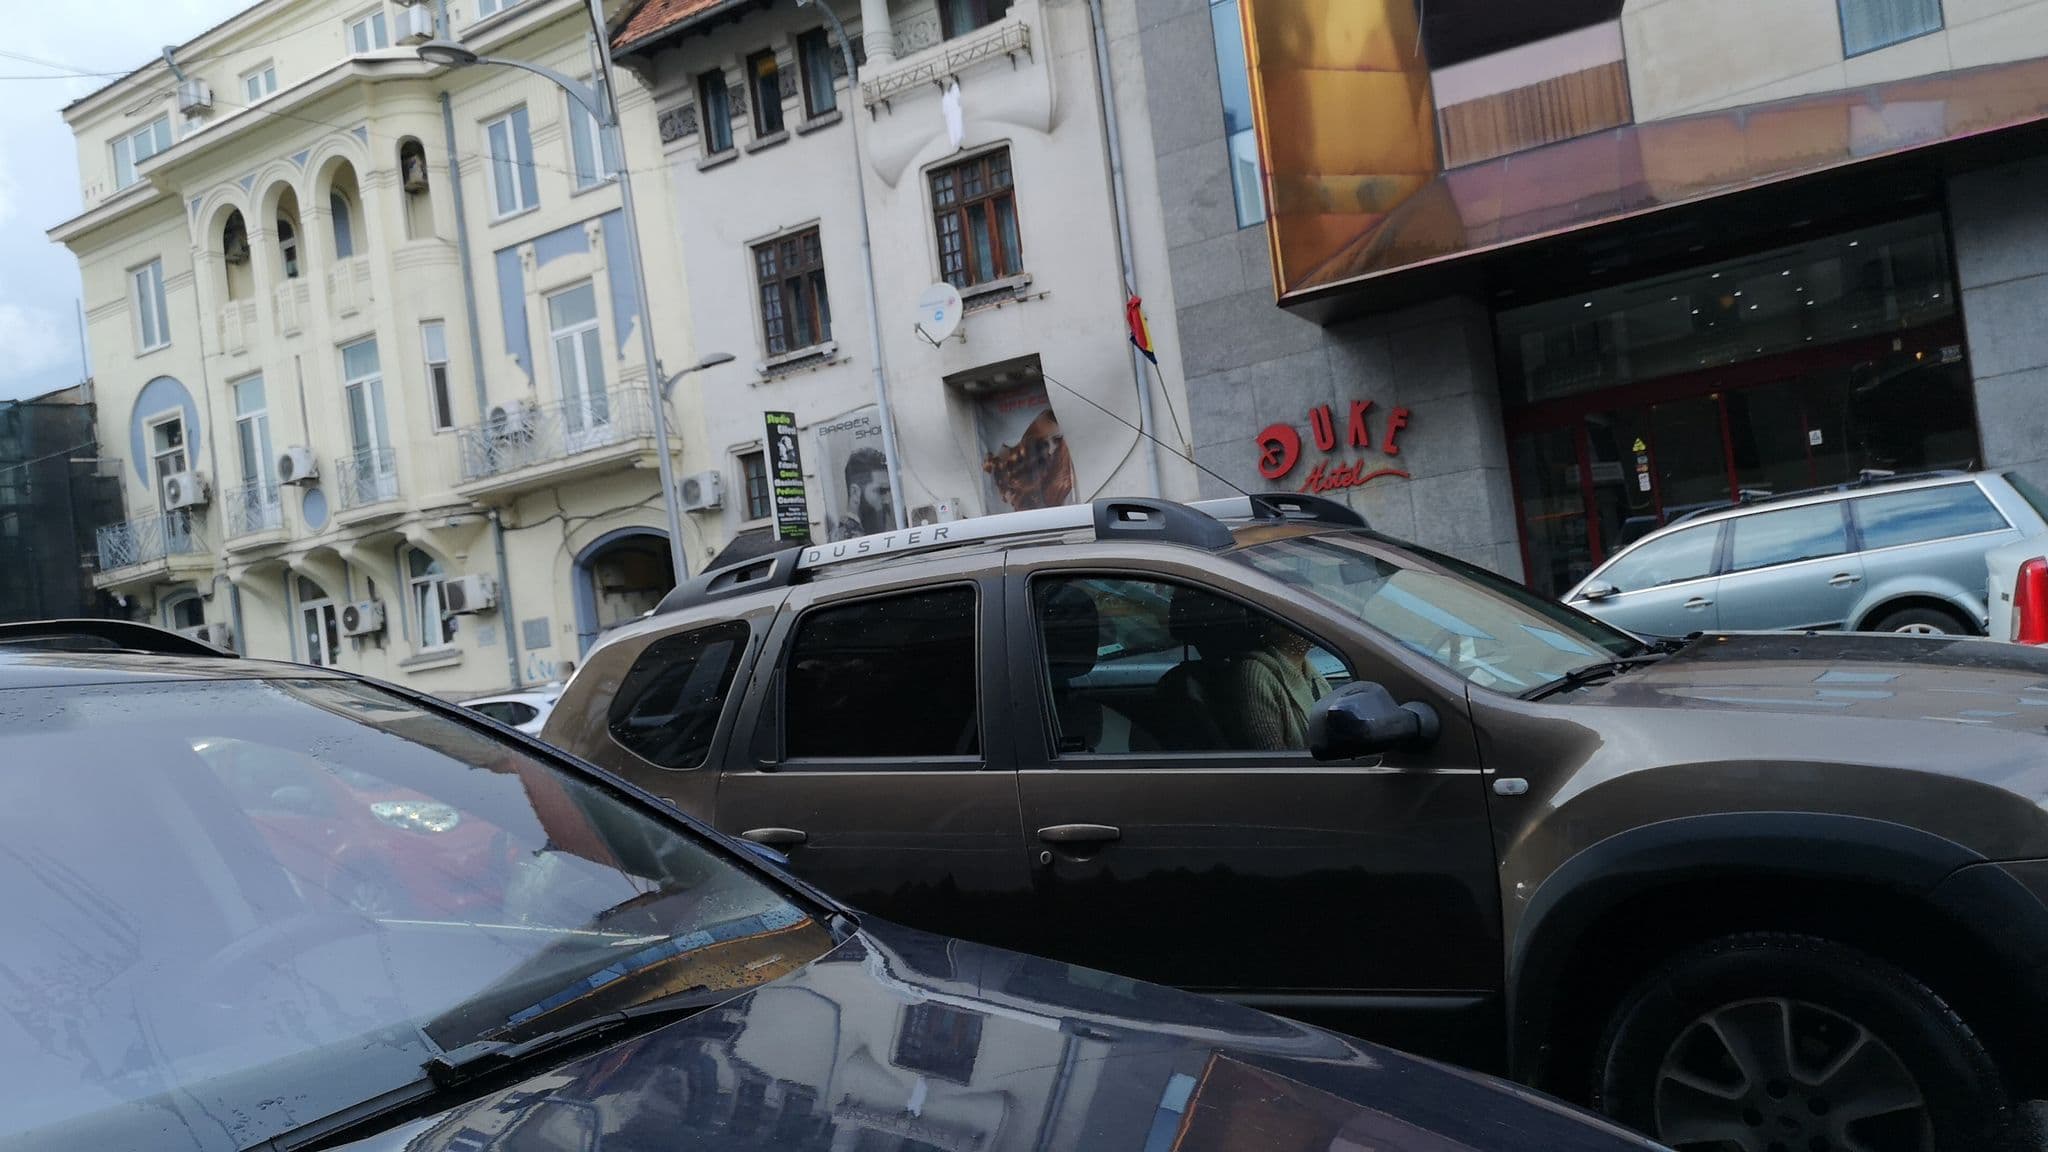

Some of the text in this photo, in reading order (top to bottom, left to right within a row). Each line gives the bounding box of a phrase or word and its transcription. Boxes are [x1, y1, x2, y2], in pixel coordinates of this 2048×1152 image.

[819, 417, 869, 436] BARBER
[855, 425, 882, 440] SHO
[1255, 400, 1411, 480] DUKE
[1299, 458, 1411, 494] Hotel
[808, 527, 949, 563] DUSTER
